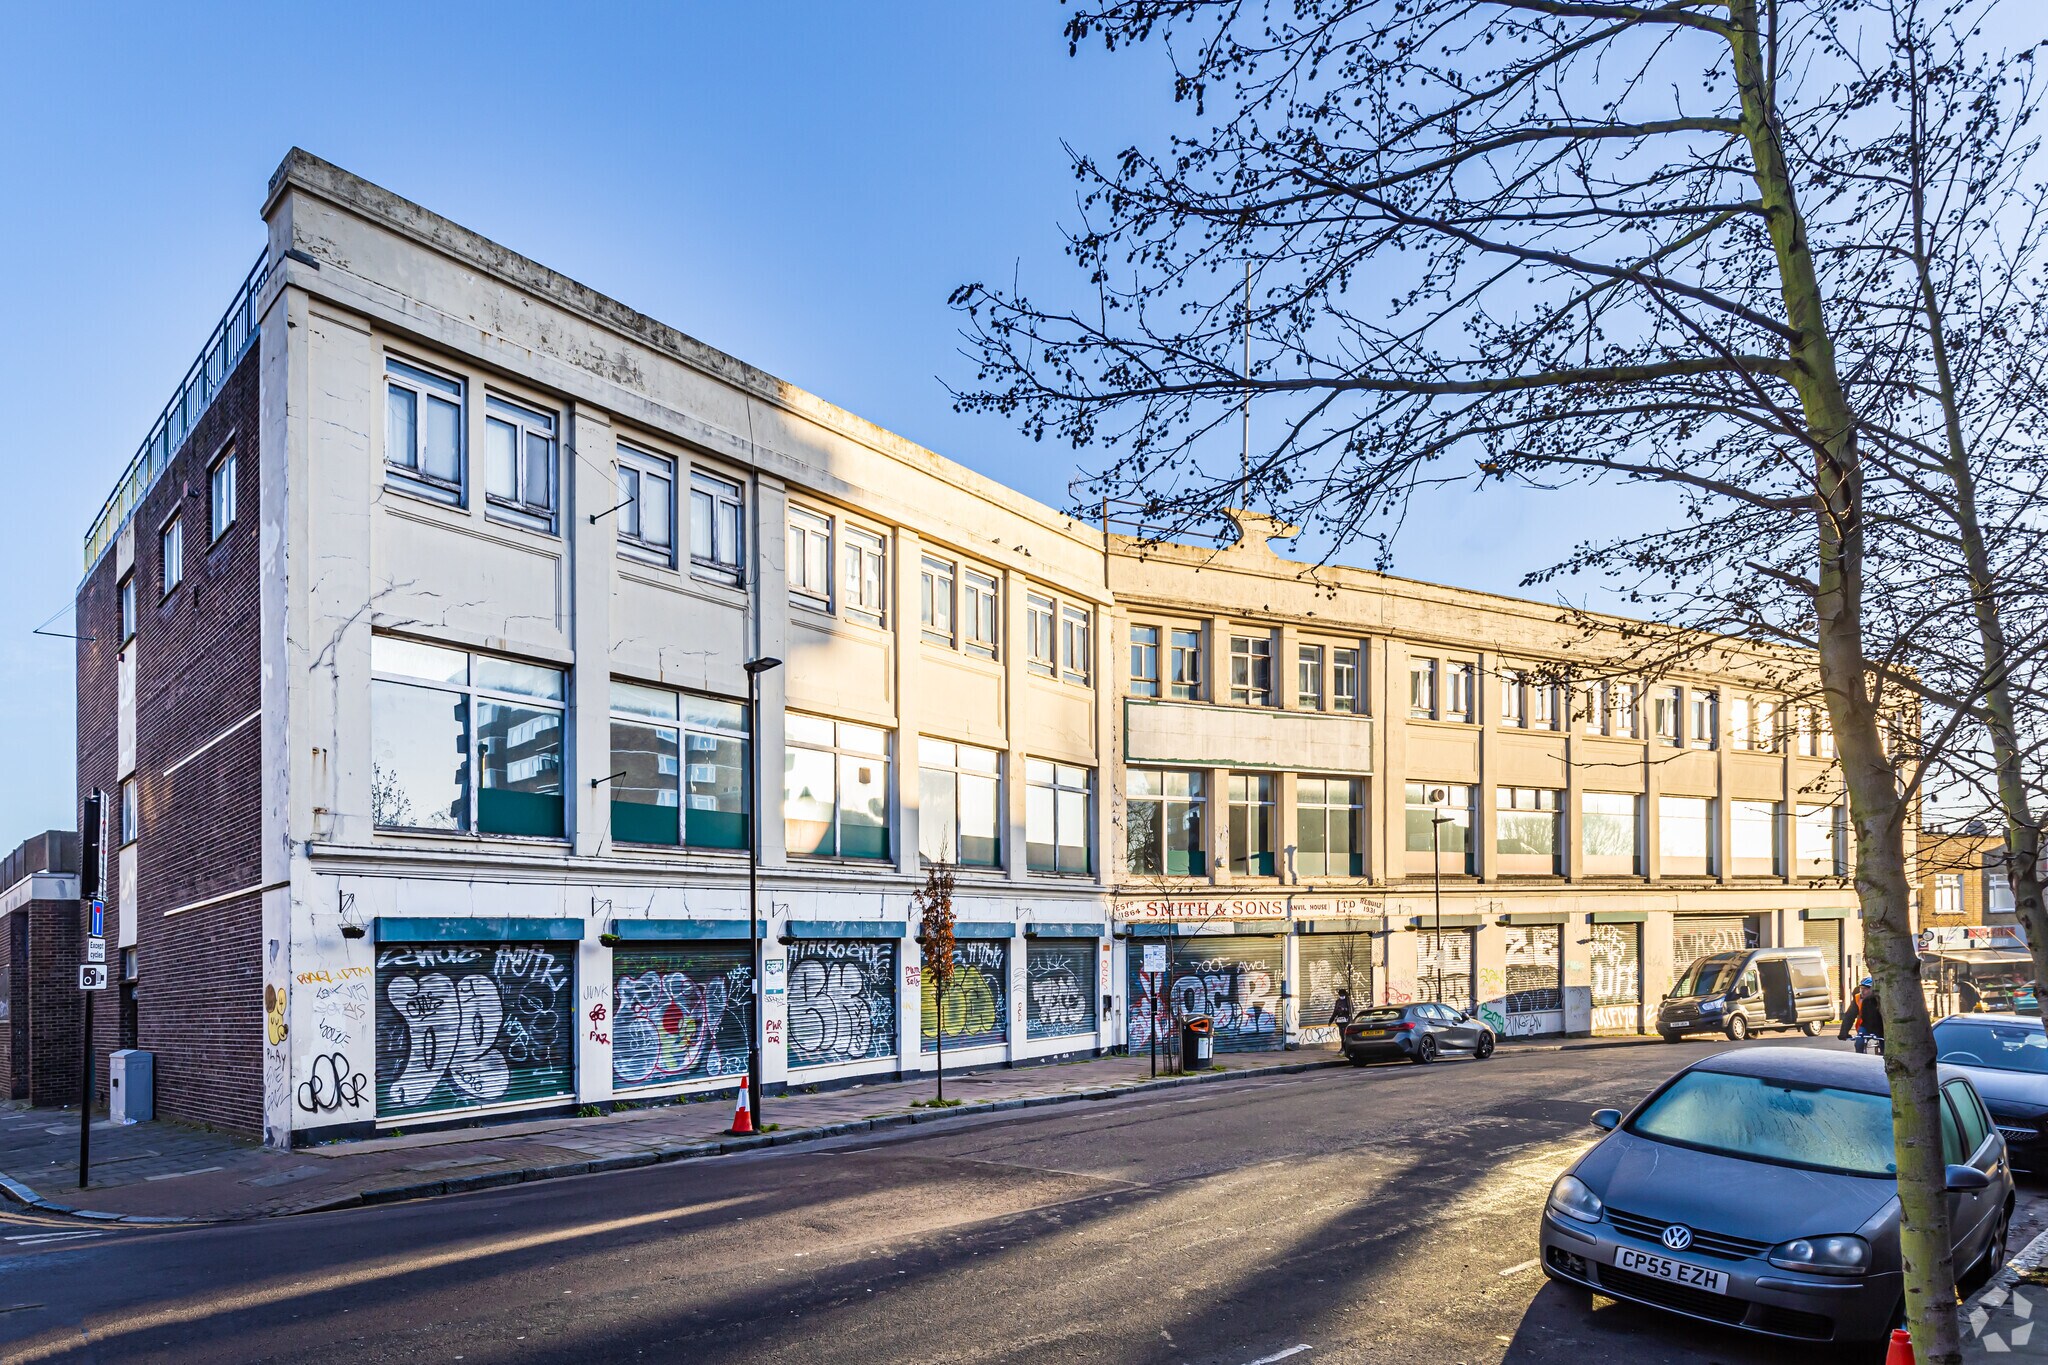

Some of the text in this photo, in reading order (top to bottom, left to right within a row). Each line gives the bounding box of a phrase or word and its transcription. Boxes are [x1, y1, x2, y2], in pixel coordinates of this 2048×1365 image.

[1146, 902, 1209, 917] SMITH
[1215, 903, 1227, 916] &
[1232, 901, 1283, 916] SONS
[90, 941, 104, 950] Except
[90, 951, 104, 959] cycles
[267, 1048, 286, 1071] PLAY
[1622, 1250, 1719, 1289] CP55 EZH
